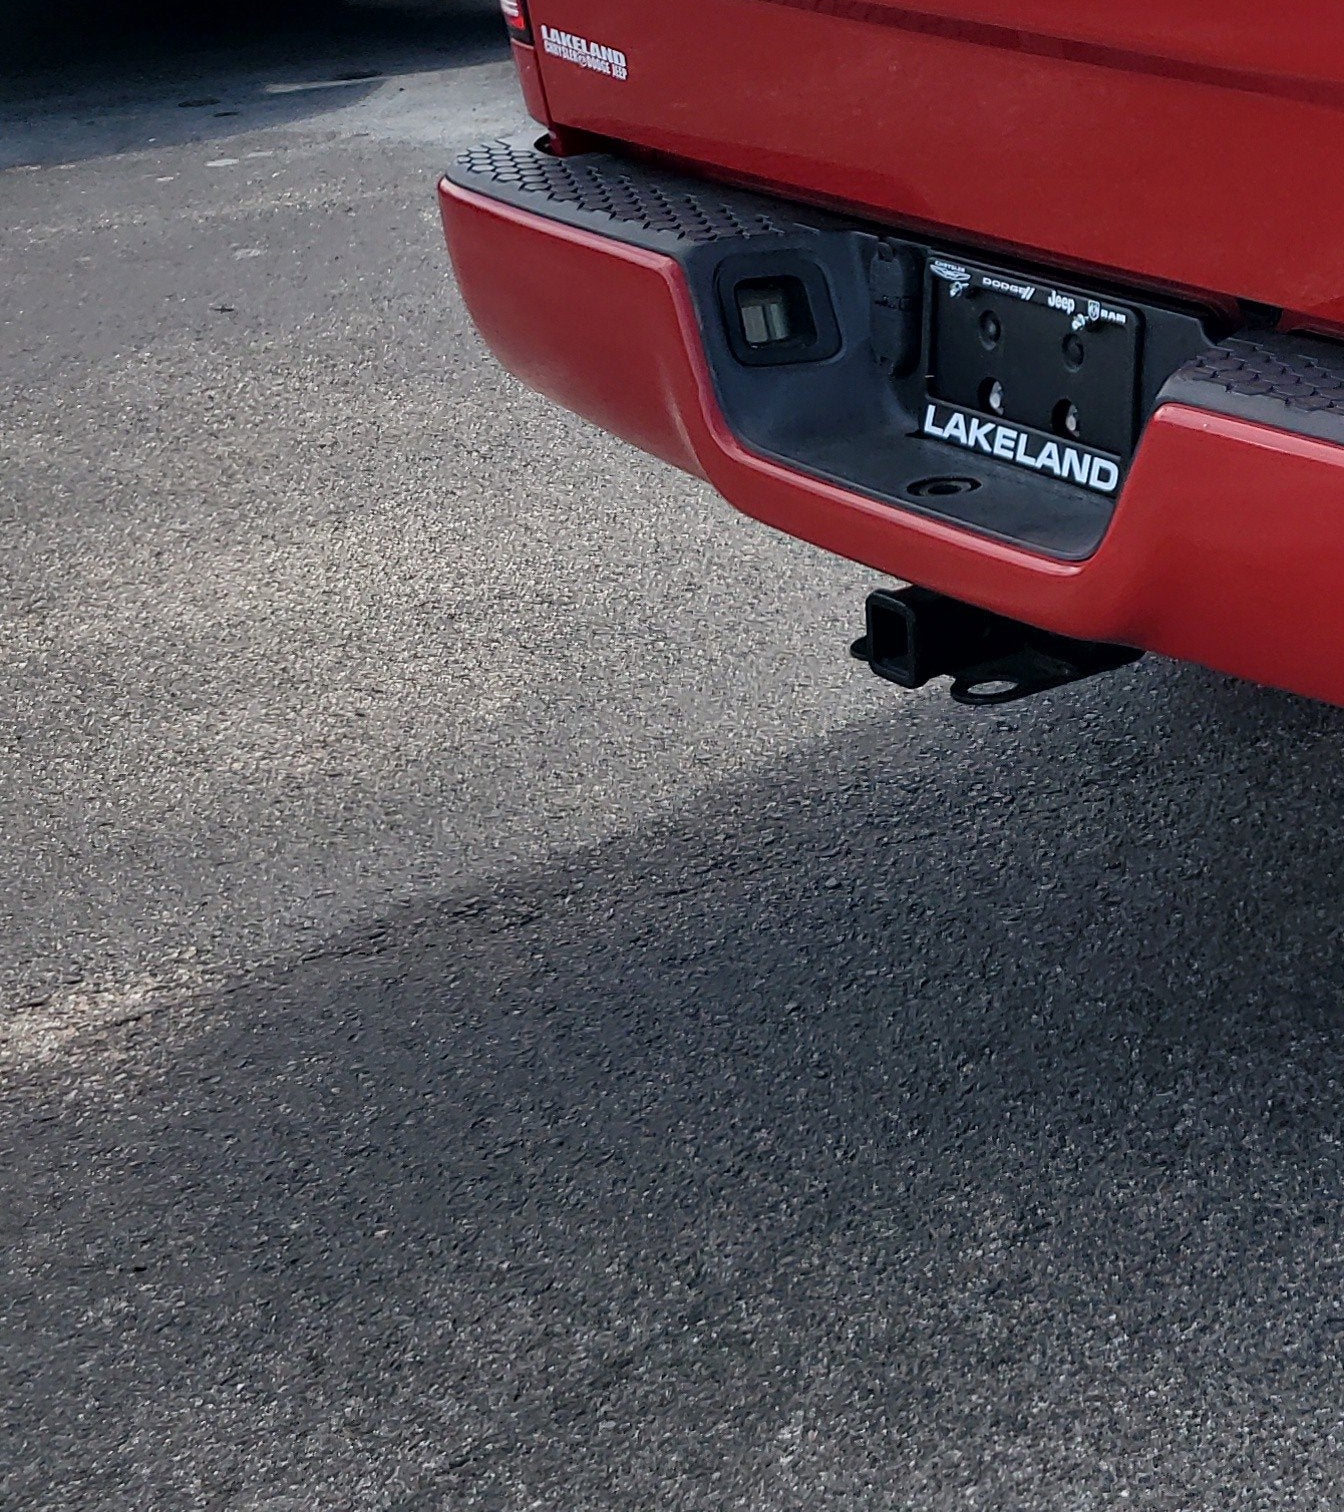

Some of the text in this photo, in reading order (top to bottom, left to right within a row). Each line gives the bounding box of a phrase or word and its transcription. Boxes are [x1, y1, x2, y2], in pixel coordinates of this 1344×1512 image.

[541, 24, 627, 68] LAKELAND
[982, 277, 1026, 296] DODGE
[1048, 290, 1076, 316] Jeep
[1099, 308, 1127, 324] RAM
[923, 404, 1119, 492] LAKELAND
